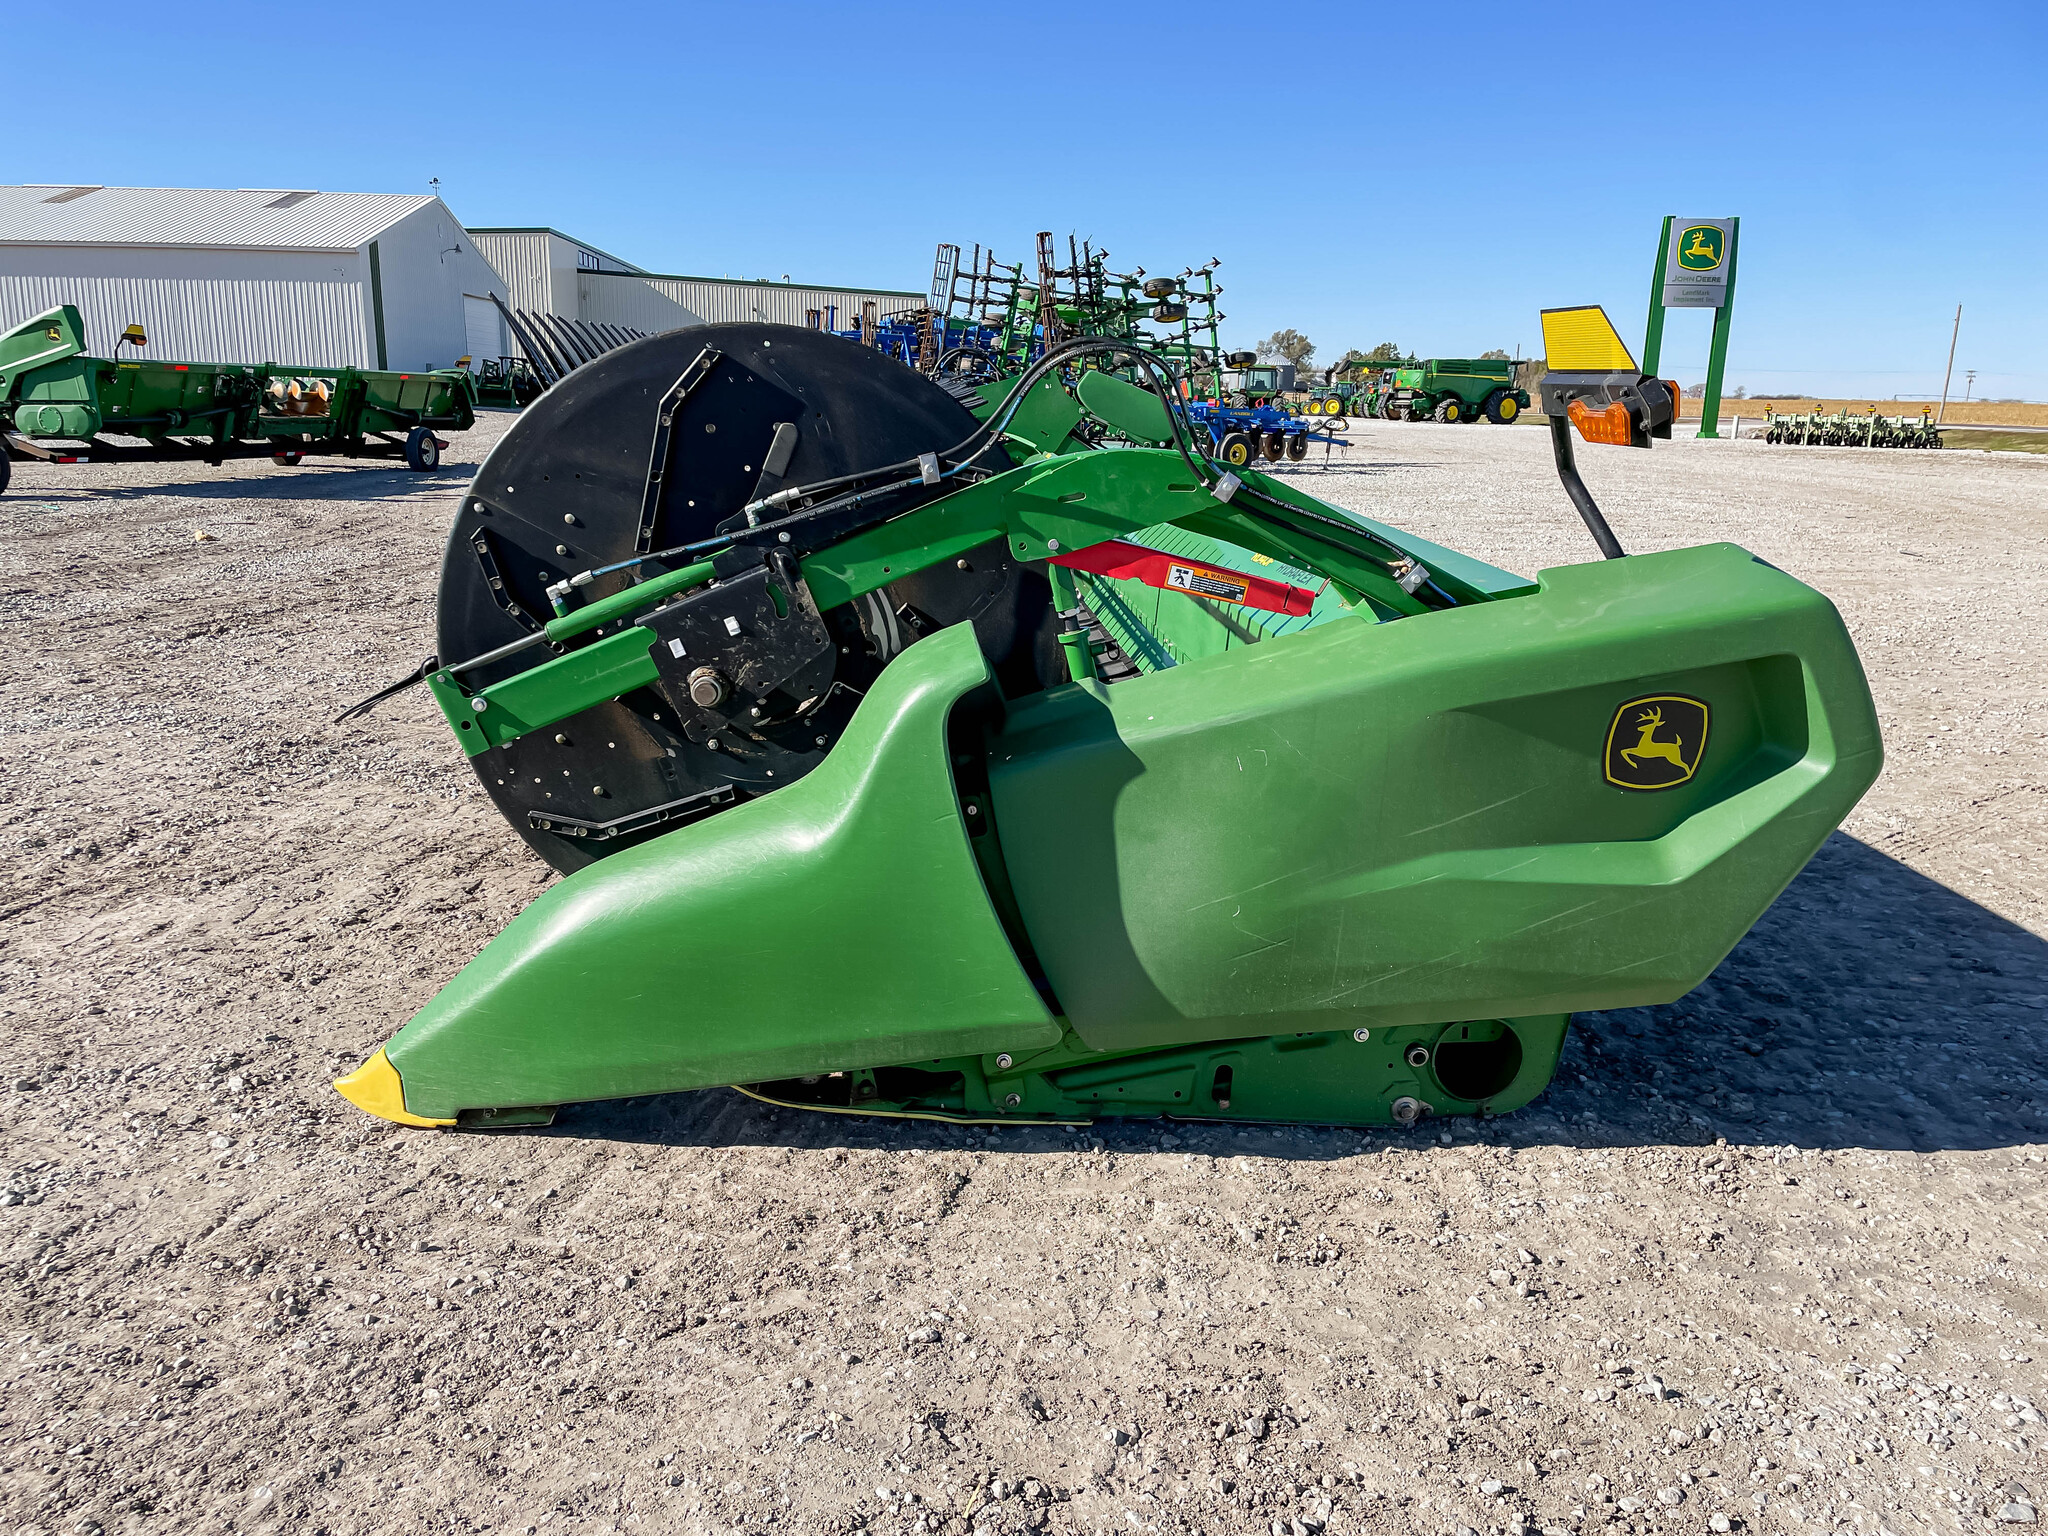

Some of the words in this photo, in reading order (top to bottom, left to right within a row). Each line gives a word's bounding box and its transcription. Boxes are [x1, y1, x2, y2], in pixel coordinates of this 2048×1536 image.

[1696, 275, 1721, 283] DEERE
[1210, 572, 1241, 585] WARNING
[1276, 563, 1316, 586] HYDRAFLEX
